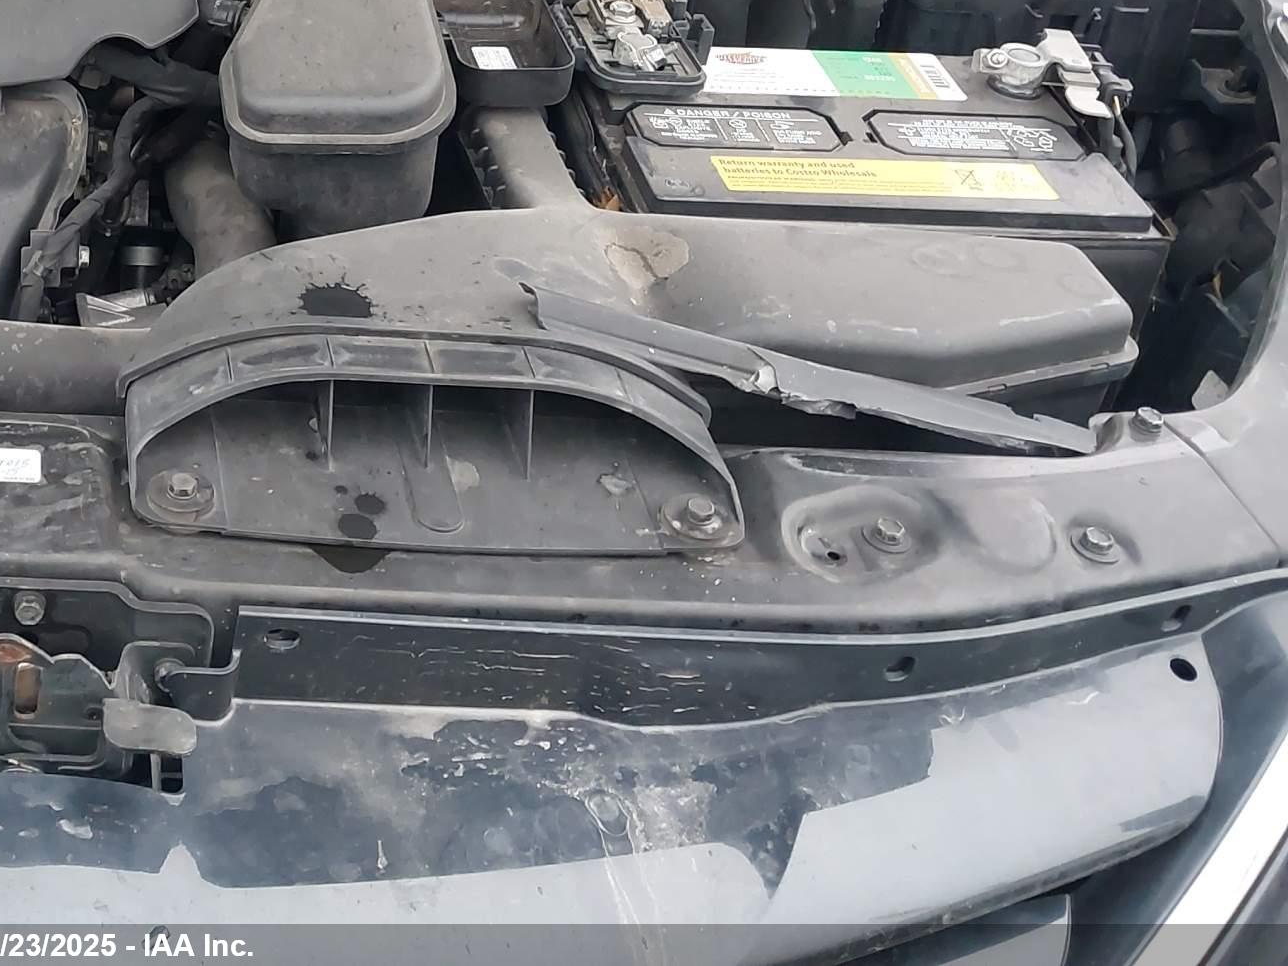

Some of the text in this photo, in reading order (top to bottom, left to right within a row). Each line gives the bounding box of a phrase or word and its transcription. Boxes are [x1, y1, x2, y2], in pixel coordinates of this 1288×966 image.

[676, 108, 730, 118] DANGER
[742, 111, 792, 119] POISON
[718, 158, 754, 166] Return
[756, 160, 805, 169] warranty
[723, 166, 771, 174] batteries
[786, 168, 820, 176] Costco
[821, 169, 879, 178] Wholesale
